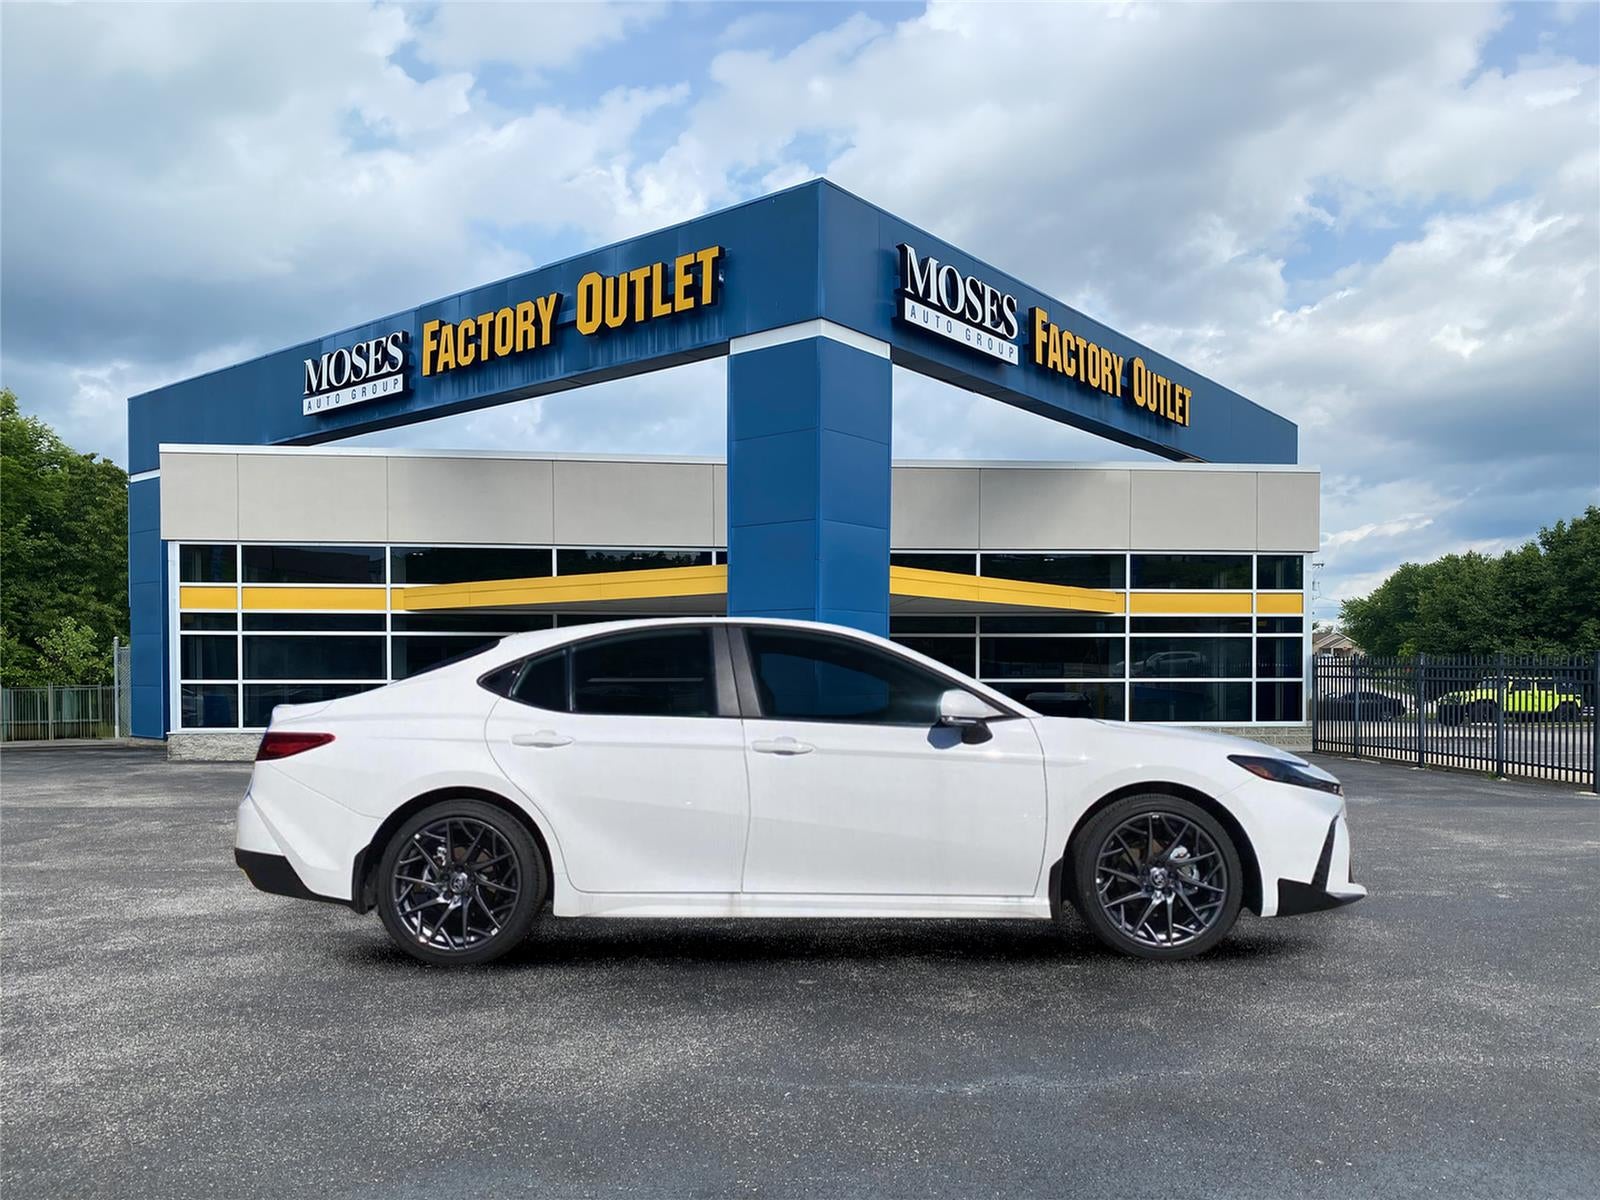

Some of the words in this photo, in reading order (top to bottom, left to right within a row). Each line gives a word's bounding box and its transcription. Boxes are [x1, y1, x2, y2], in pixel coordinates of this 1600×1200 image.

[422, 293, 559, 377] FACTORY
[576, 245, 721, 336] OUTLET
[904, 243, 1019, 340] MOSES
[909, 304, 953, 334] AUTO
[965, 328, 1015, 359] GROUP
[303, 331, 404, 395] MOSES
[307, 393, 341, 411] AUTO
[351, 378, 400, 400] GROUP
[1034, 306, 1124, 398] FACTORY
[1132, 356, 1193, 427] OUTLET
